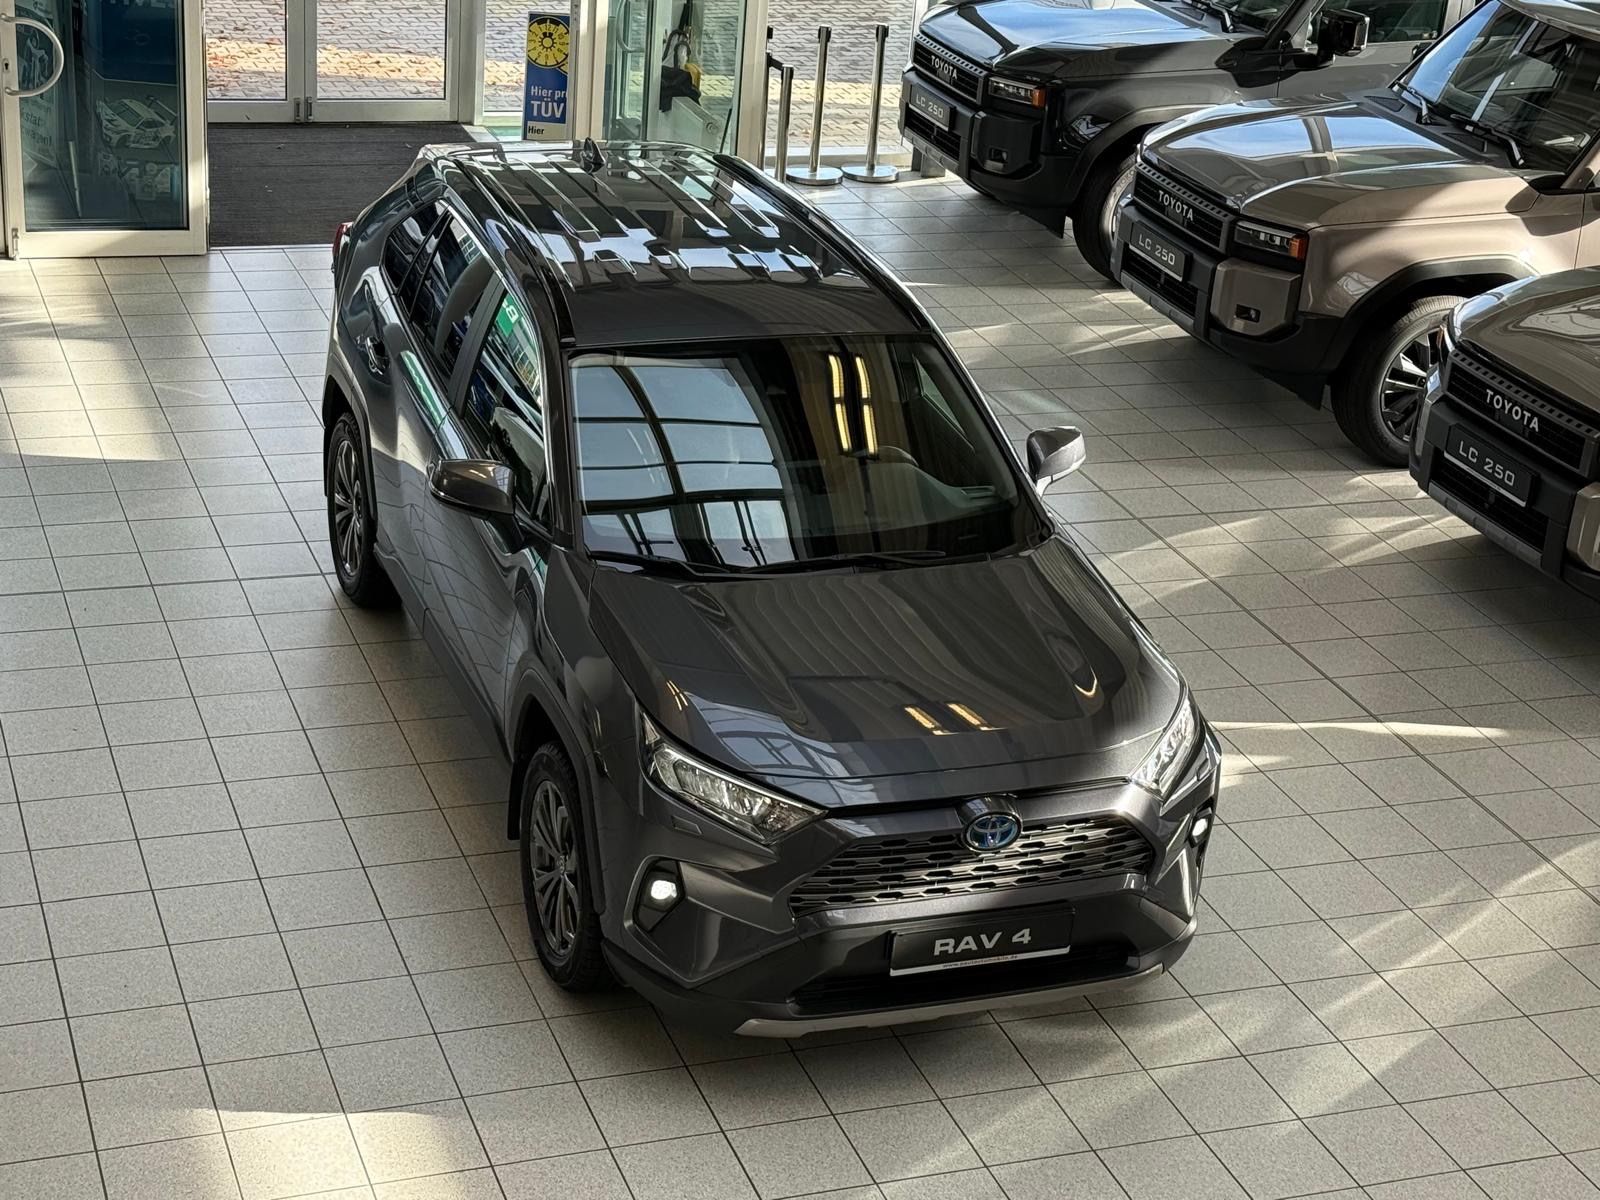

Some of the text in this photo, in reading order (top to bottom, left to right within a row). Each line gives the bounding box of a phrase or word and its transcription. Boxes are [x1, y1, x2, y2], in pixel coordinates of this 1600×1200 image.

[931, 55, 957, 80] TOYOTA
[531, 85, 553, 97] Hier
[530, 97, 565, 119] TÜV
[916, 93, 944, 118] LC 250
[528, 125, 545, 135] Hier
[1159, 190, 1194, 221] TOYOTA
[1138, 234, 1176, 266] LC 250
[1486, 388, 1539, 433] TOYOTA
[1459, 440, 1515, 487] LC 250
[933, 927, 1032, 956] RAV 4
